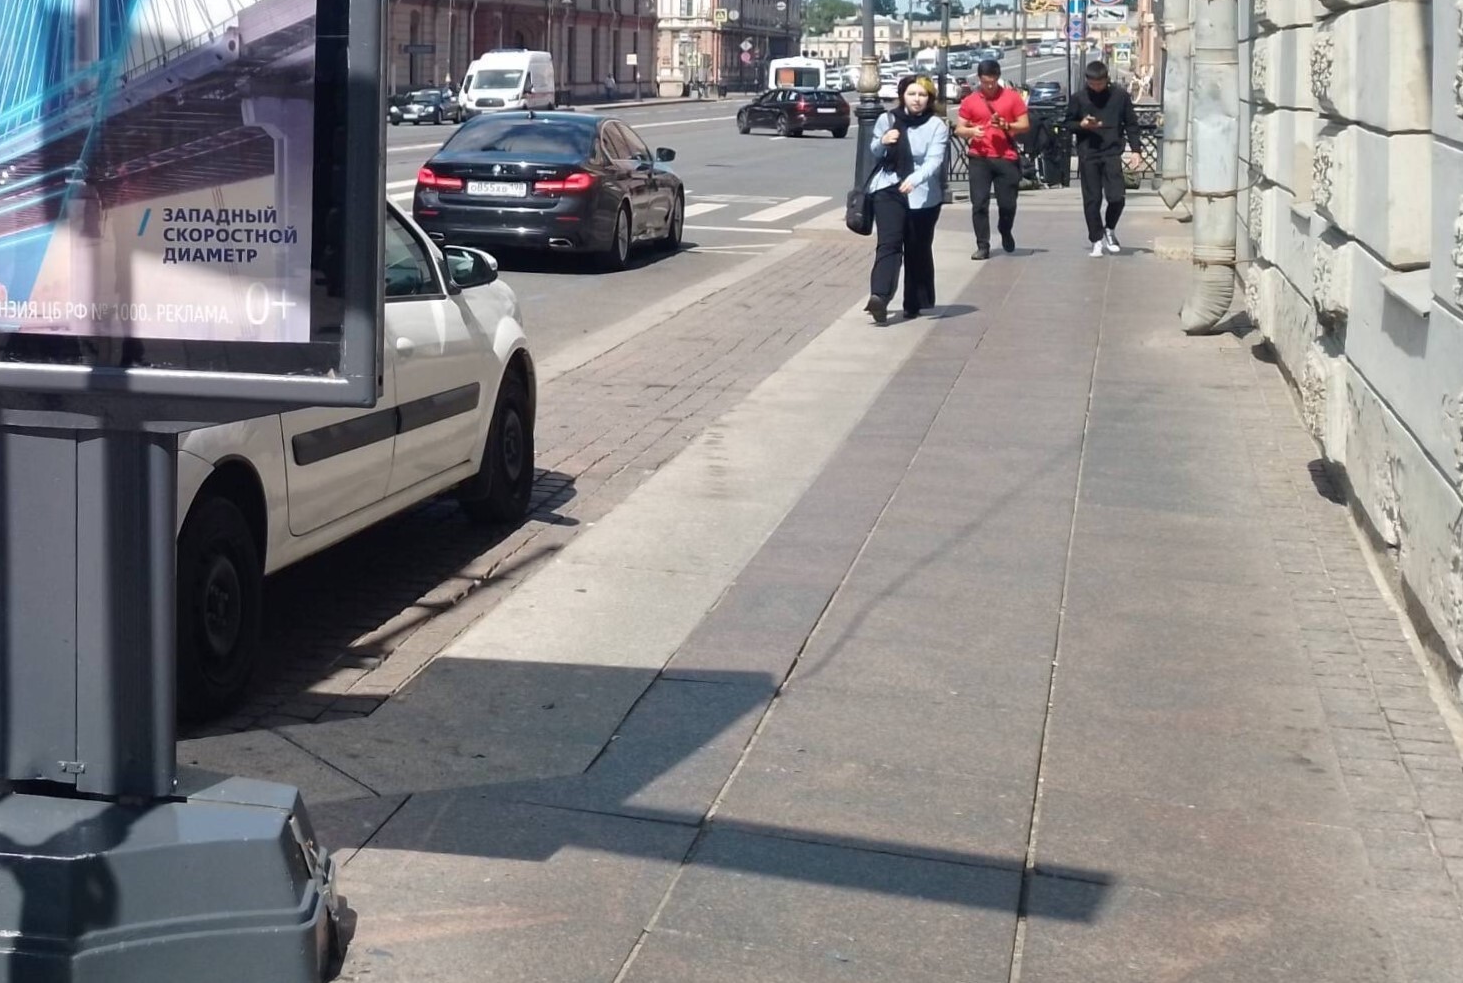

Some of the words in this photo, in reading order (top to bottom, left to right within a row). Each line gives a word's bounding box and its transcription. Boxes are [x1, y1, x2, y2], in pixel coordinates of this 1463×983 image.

[162, 206, 277, 226] ЗАПАДНЫЙ
[162, 225, 297, 244] СКОРОСТНОЙ
[162, 247, 258, 264] ДИАМЕТР
[42, 301, 62, 322] ЦБ
[65, 301, 87, 321] РФ
[91, 302, 109, 322] №
[113, 303, 152, 322] 1000.
[157, 303, 234, 324] РЕКЛАМА.
[245, 281, 297, 326] 0+
